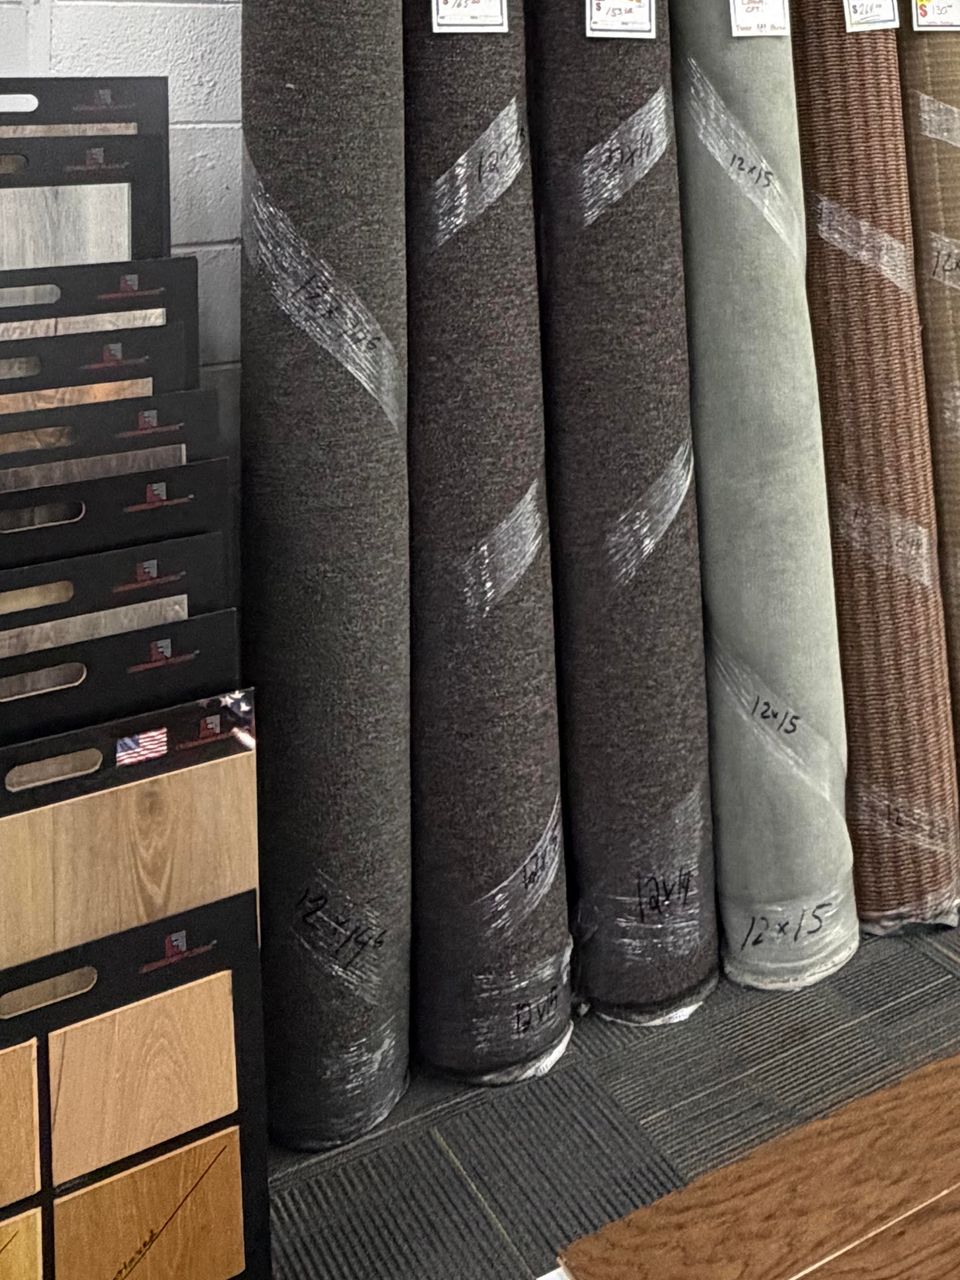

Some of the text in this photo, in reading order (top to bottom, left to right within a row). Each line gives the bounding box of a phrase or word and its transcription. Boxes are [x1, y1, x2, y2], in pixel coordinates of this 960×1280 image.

[729, 153, 774, 188] 12x15
[751, 696, 800, 734] 12x15
[740, 903, 833, 951] 12x15
